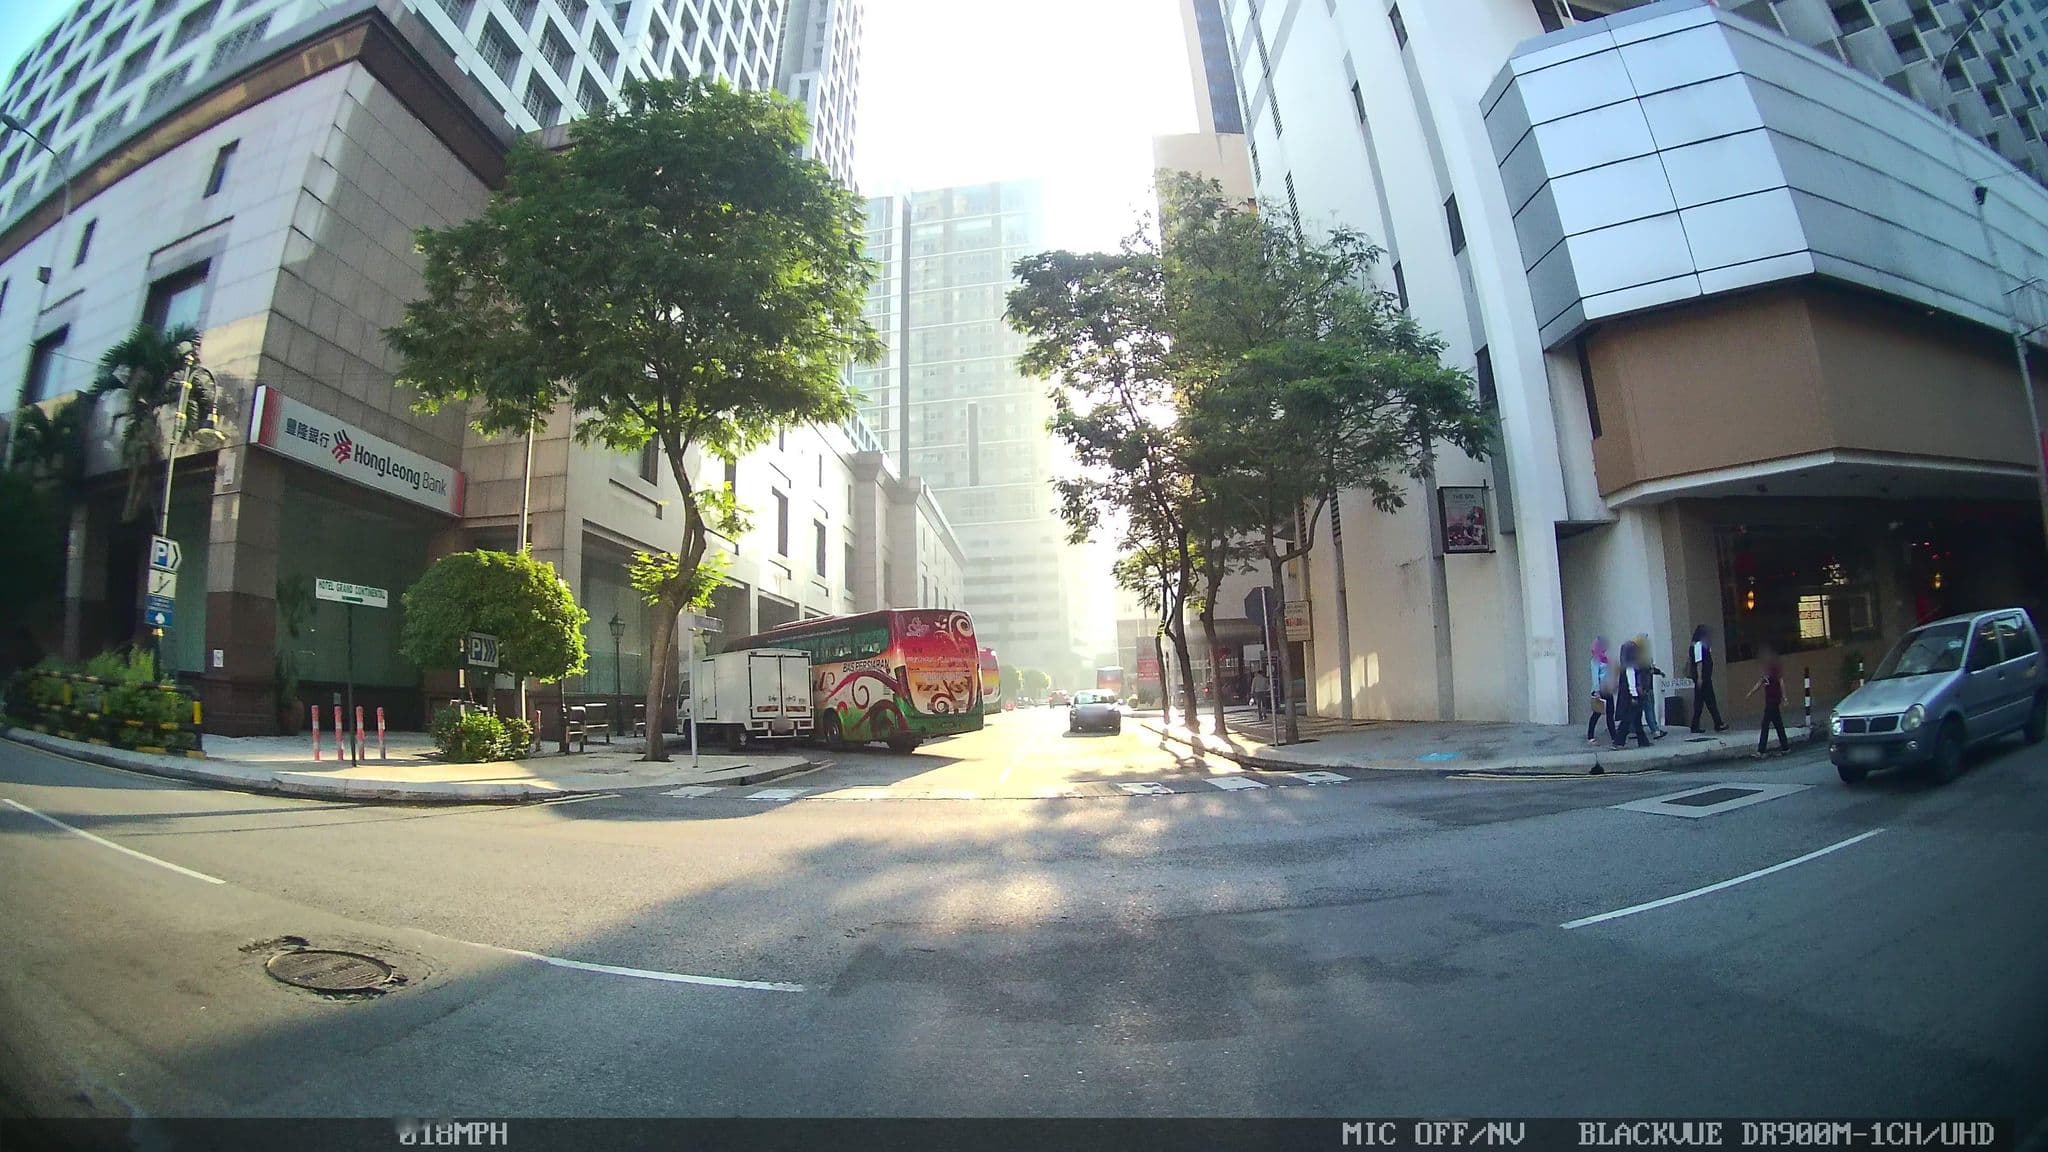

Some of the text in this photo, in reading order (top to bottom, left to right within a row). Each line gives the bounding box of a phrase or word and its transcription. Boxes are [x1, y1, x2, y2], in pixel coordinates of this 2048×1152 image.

[285, 418, 330, 449] 豐隆銀行
[422, 471, 447, 496] Bank
[319, 580, 335, 591] HOTEL
[336, 583, 353, 593] GRAND
